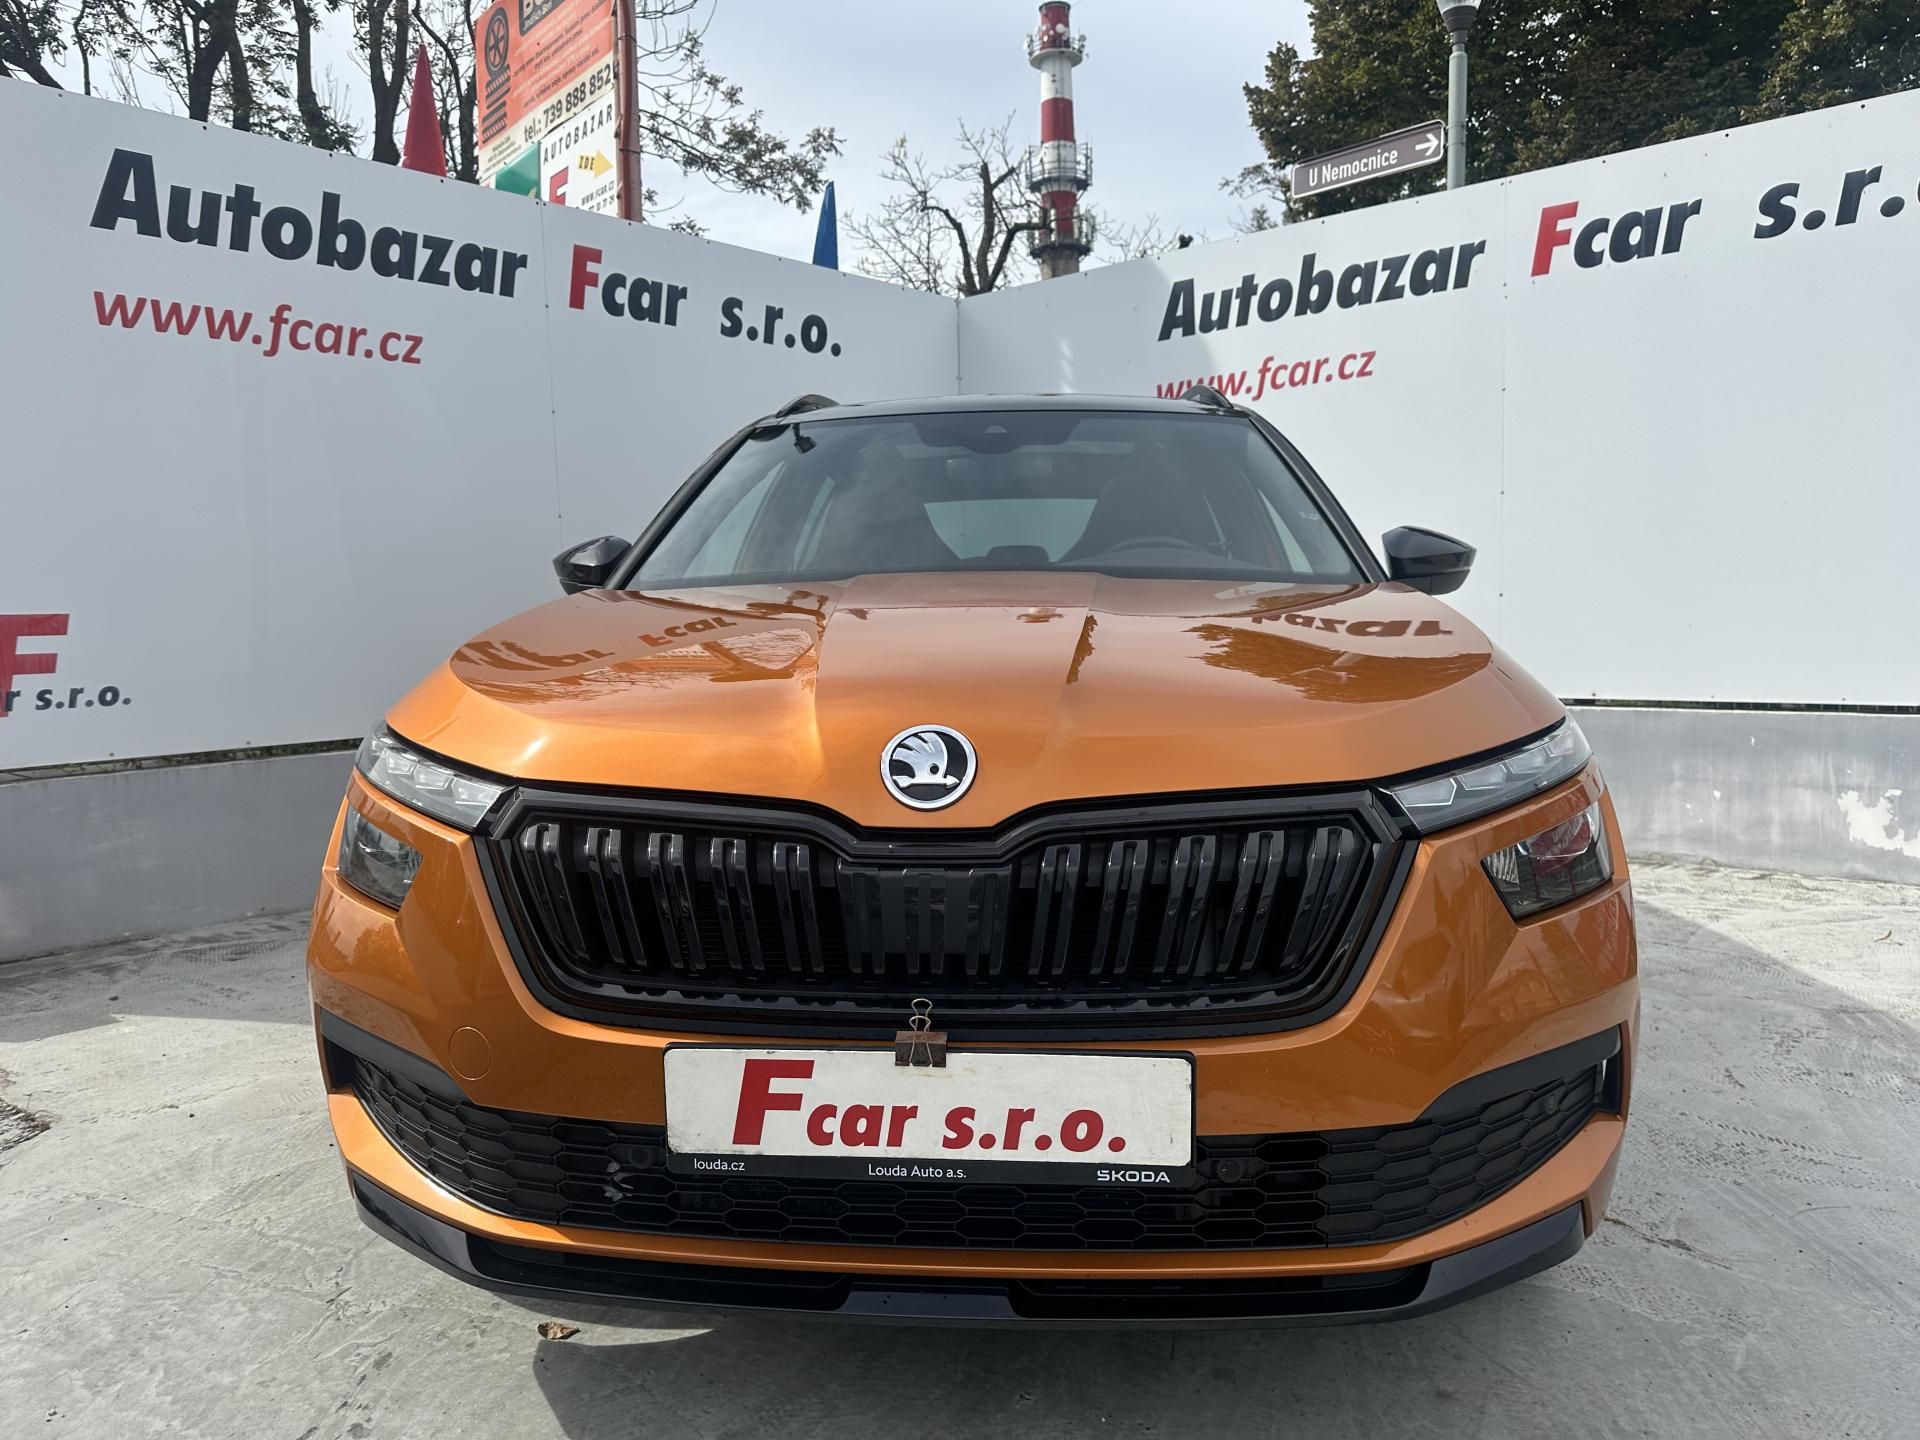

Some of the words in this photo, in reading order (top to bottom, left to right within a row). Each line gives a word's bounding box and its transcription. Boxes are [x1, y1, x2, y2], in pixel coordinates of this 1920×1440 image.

[543, 99, 563, 129] 739
[565, 81, 587, 113] 888
[589, 63, 611, 96] 852
[543, 103, 613, 166] AUTOBAZAR
[578, 155, 595, 171] ZDE
[1308, 167, 1318, 187] U
[1321, 149, 1398, 185] Nemocnice
[90, 148, 528, 298] Autobazar
[569, 244, 688, 327] Fcar
[720, 297, 842, 357] s.r.o.
[1157, 239, 1487, 342] Autobazar
[1530, 198, 1703, 278] Fcar
[1753, 165, 1920, 239] s.r.
[93, 290, 424, 365] www.fcar.cz
[35, 685, 132, 711] s.r.o.
[731, 1058, 918, 1148] Fcar
[942, 1106, 1127, 1153] s.r.o.
[694, 1158, 745, 1171] louda.cz
[868, 1163, 907, 1177] Louda
[911, 1165, 943, 1178] Auto
[946, 1167, 967, 1179] a.s.
